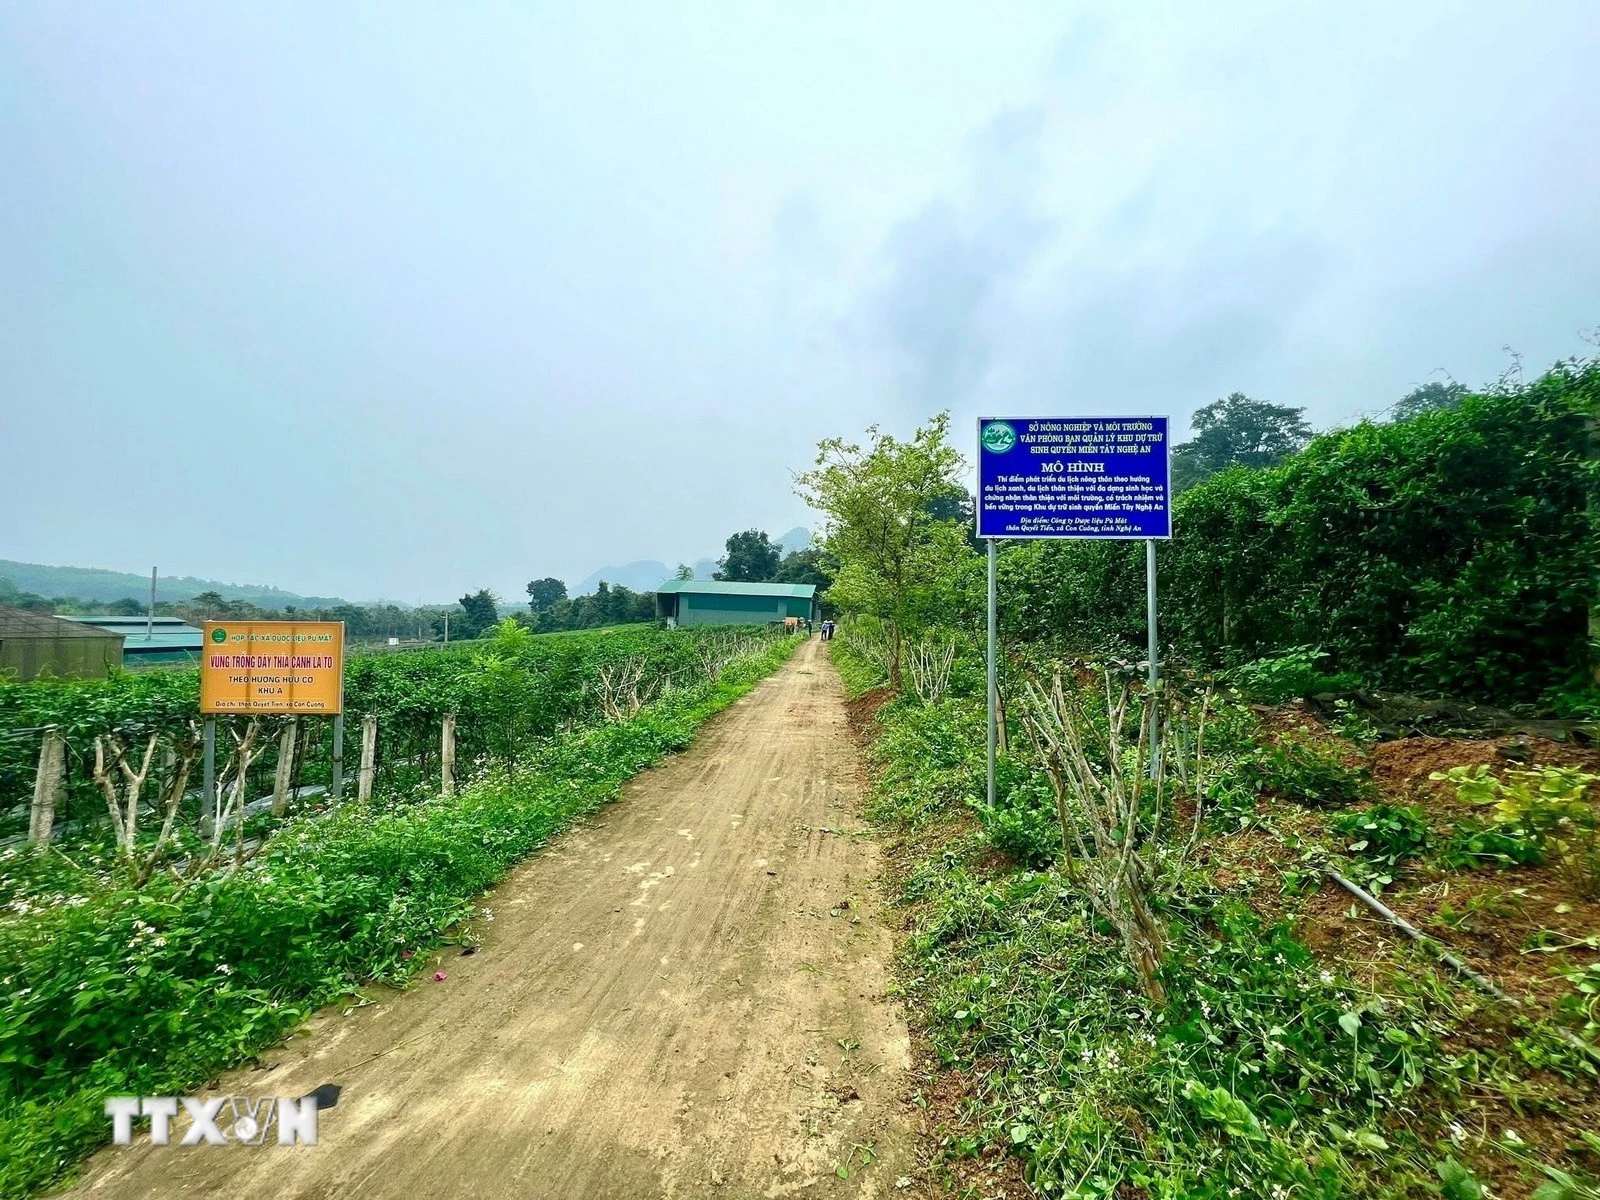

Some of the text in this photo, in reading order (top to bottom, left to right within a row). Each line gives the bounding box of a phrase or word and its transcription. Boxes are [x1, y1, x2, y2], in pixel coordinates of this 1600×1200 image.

[1028, 421, 1152, 432] SỞ NÔNG NGHIỆP VÀ MÔI TRƯỜNG
[1020, 434, 1036, 443] VĂN
[1038, 433, 1063, 443] PHÒNG
[1082, 432, 1103, 443] QUẢN
[1105, 432, 1115, 442] LÝ
[1135, 434, 1146, 443] DỰ
[1147, 432, 1163, 441] TRỮ
[1050, 442, 1076, 454] QUYỂN
[1100, 444, 1115, 453] TÂY
[1117, 443, 1138, 455] NGHỆ
[1041, 460, 1104, 472] MÔ HÌNH
[1009, 474, 1024, 482] điểm
[1042, 474, 1056, 482] triển
[1067, 476, 1079, 484] lịch
[1130, 475, 1150, 484] hướng
[995, 485, 1006, 493] lịch
[1038, 485, 1049, 493] lịch
[1068, 485, 1084, 493] thiện
[1107, 485, 1124, 493] dạng
[1141, 485, 1153, 493] học
[984, 494, 1004, 502] chứng
[1005, 494, 1021, 502] nhận
[1039, 494, 1054, 502] thiện
[1081, 494, 1104, 502] trường,
[1134, 494, 1154, 502] nhiệm
[1048, 504, 1056, 512] dự
[1084, 502, 1103, 511] quyển
[1135, 504, 1152, 512] Nghệ
